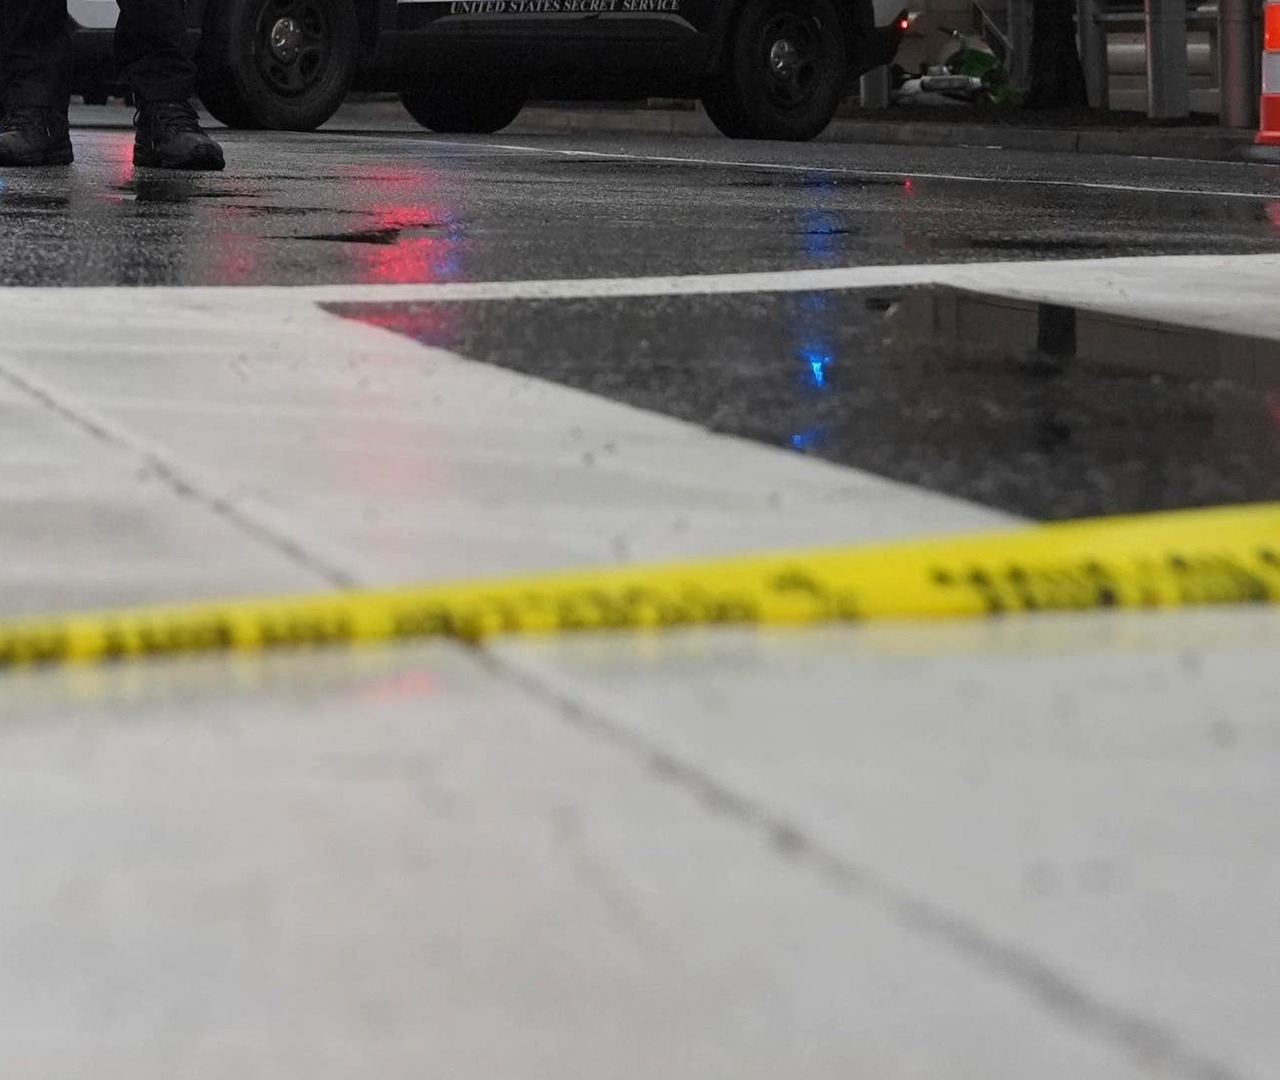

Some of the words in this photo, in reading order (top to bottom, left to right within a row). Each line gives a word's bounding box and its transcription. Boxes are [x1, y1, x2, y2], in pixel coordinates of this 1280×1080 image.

[450, 1, 505, 14] UNITED
[509, 0, 561, 12] STATES
[562, 0, 619, 12] SECRET
